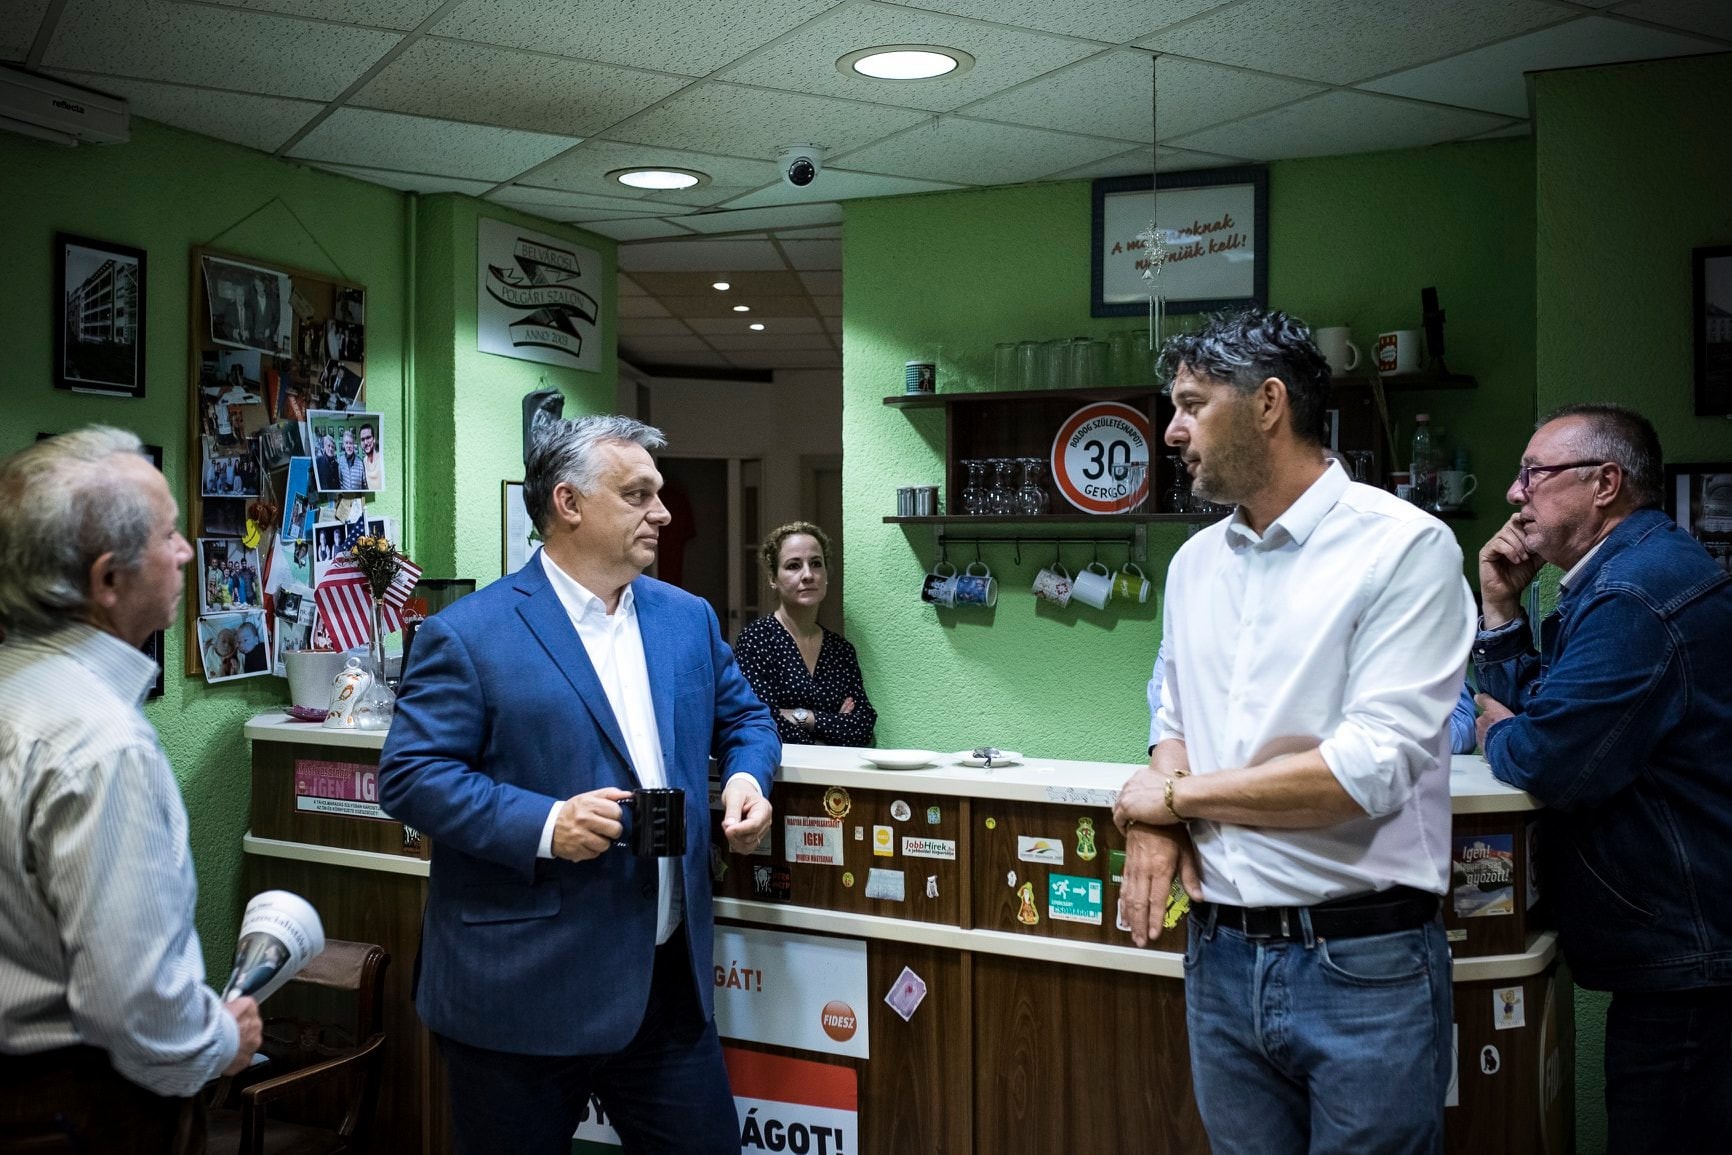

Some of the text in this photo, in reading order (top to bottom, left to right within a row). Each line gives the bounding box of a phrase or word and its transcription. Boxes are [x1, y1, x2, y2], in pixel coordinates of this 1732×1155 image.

[52, 99, 85, 114] reflecta
[1111, 213, 1235, 255] A maaroknak
[1209, 233, 1247, 254] kell!
[522, 244, 573, 267] BELVÁROSI
[502, 286, 585, 309] POLGÁRI SZALON
[1069, 416, 1144, 449] BOLDOG SZÜLETÉSNAPOT!
[1082, 439, 1131, 481] 30
[355, 771, 378, 802] IG
[803, 832, 824, 847] IGEN
[1462, 844, 1491, 863] Igen!
[823, 1013, 855, 1030] FIDESZ
